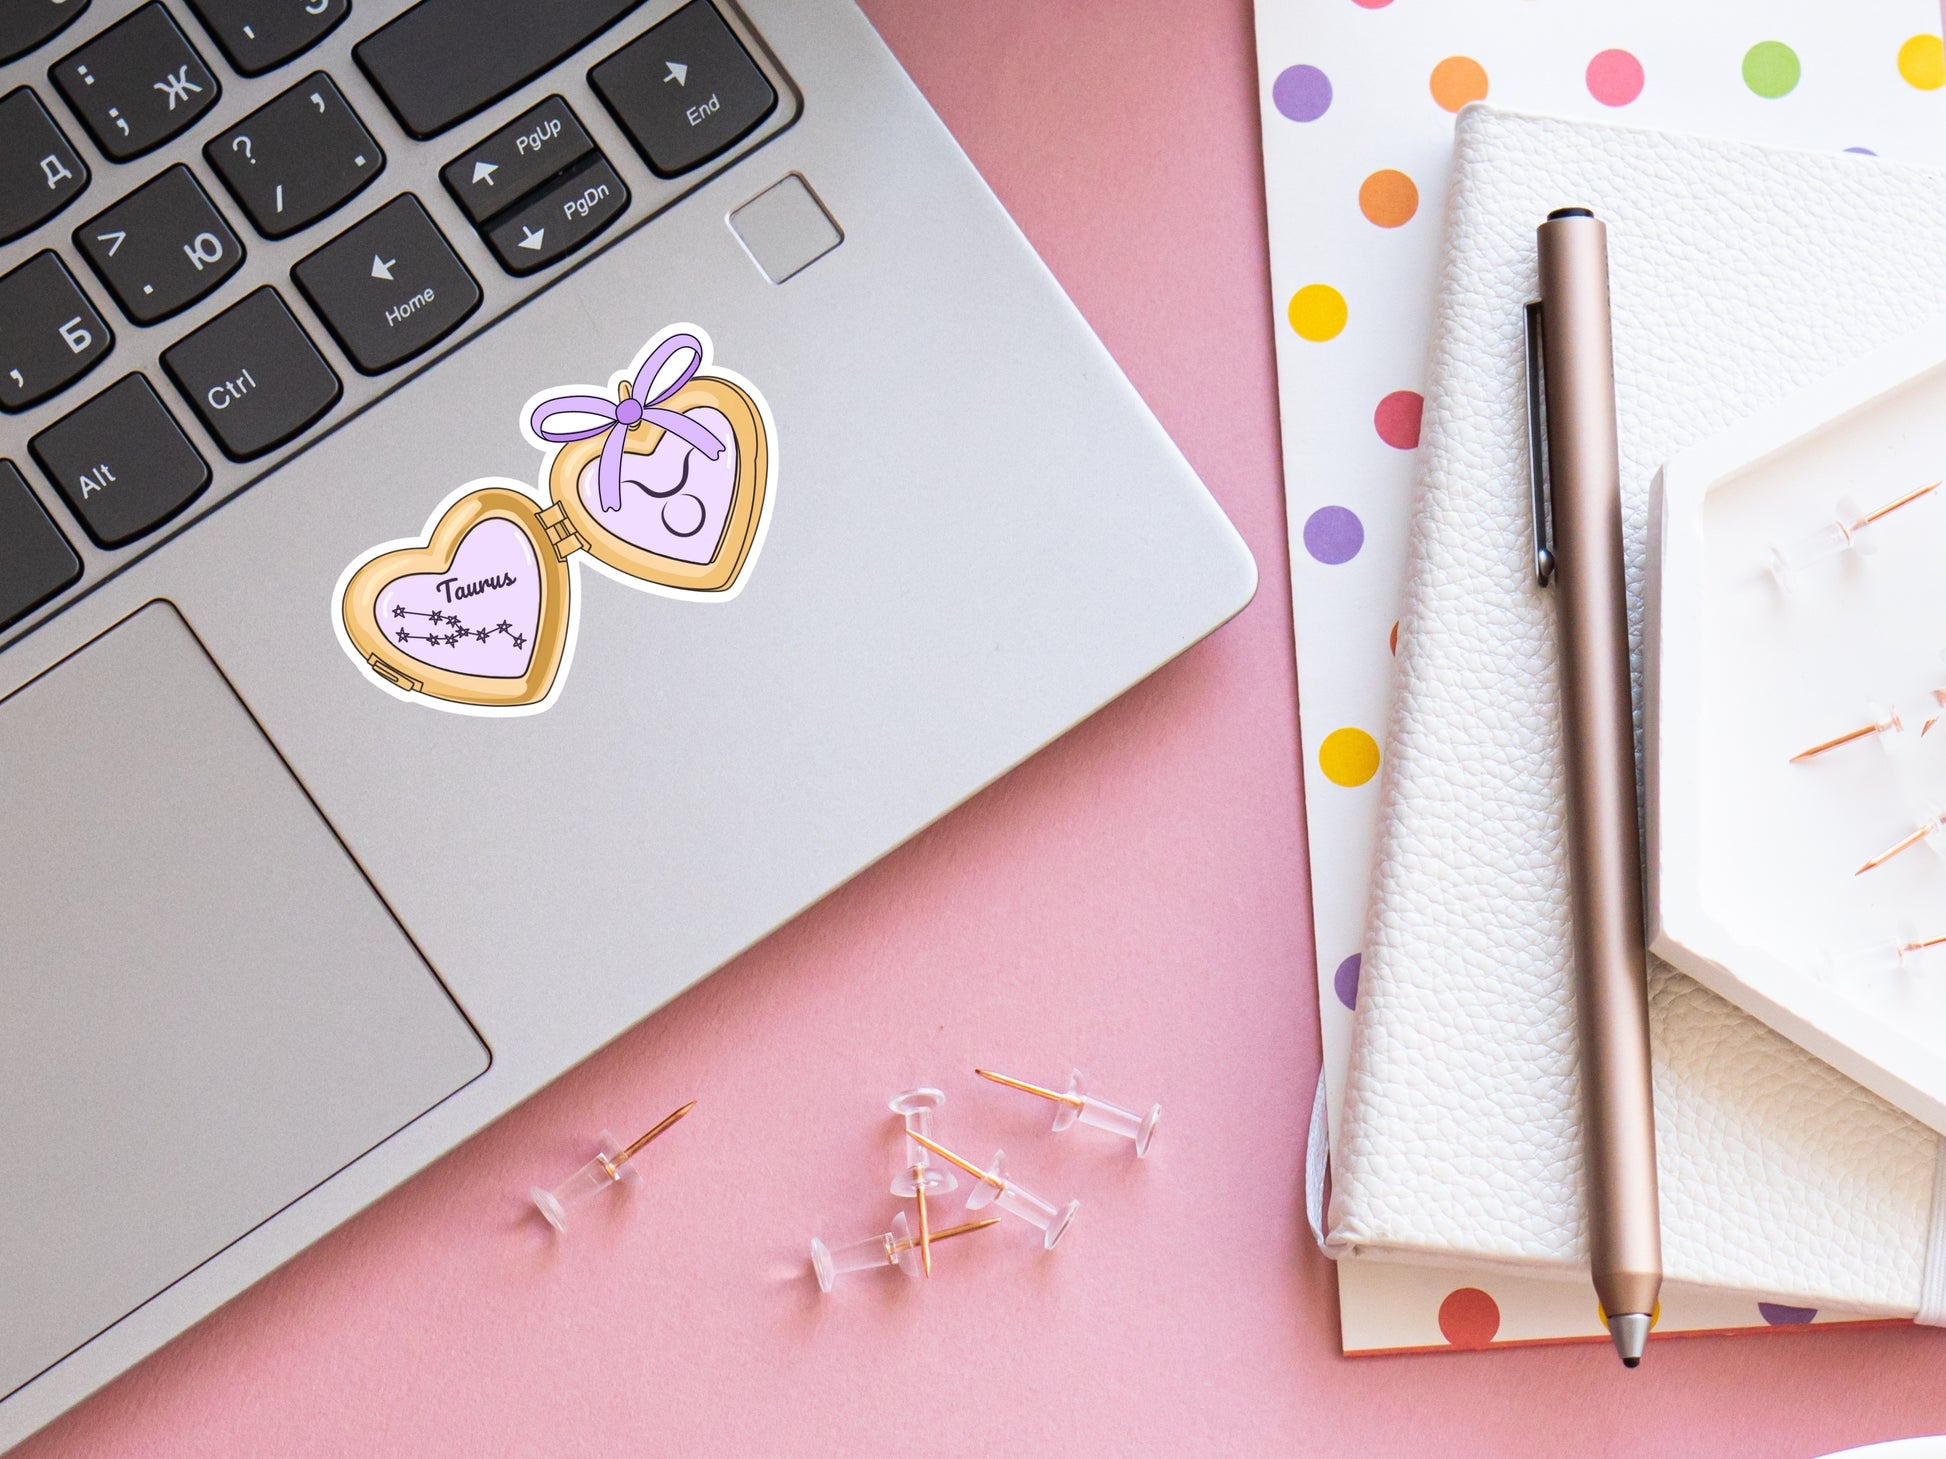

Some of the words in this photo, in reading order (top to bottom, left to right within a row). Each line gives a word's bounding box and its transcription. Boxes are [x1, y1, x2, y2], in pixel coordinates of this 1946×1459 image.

[153, 64, 203, 111] Ж
[686, 93, 721, 127] End
[232, 135, 257, 165] ?
[515, 118, 562, 156] PgUp
[39, 154, 73, 190] Д
[563, 183, 610, 221] PgDn
[183, 231, 224, 271] Ю
[384, 287, 436, 327] Home
[58, 316, 93, 354] Б
[207, 368, 257, 410] Ctrl
[79, 464, 117, 500] Alt
[436, 572, 518, 604] Taurus
